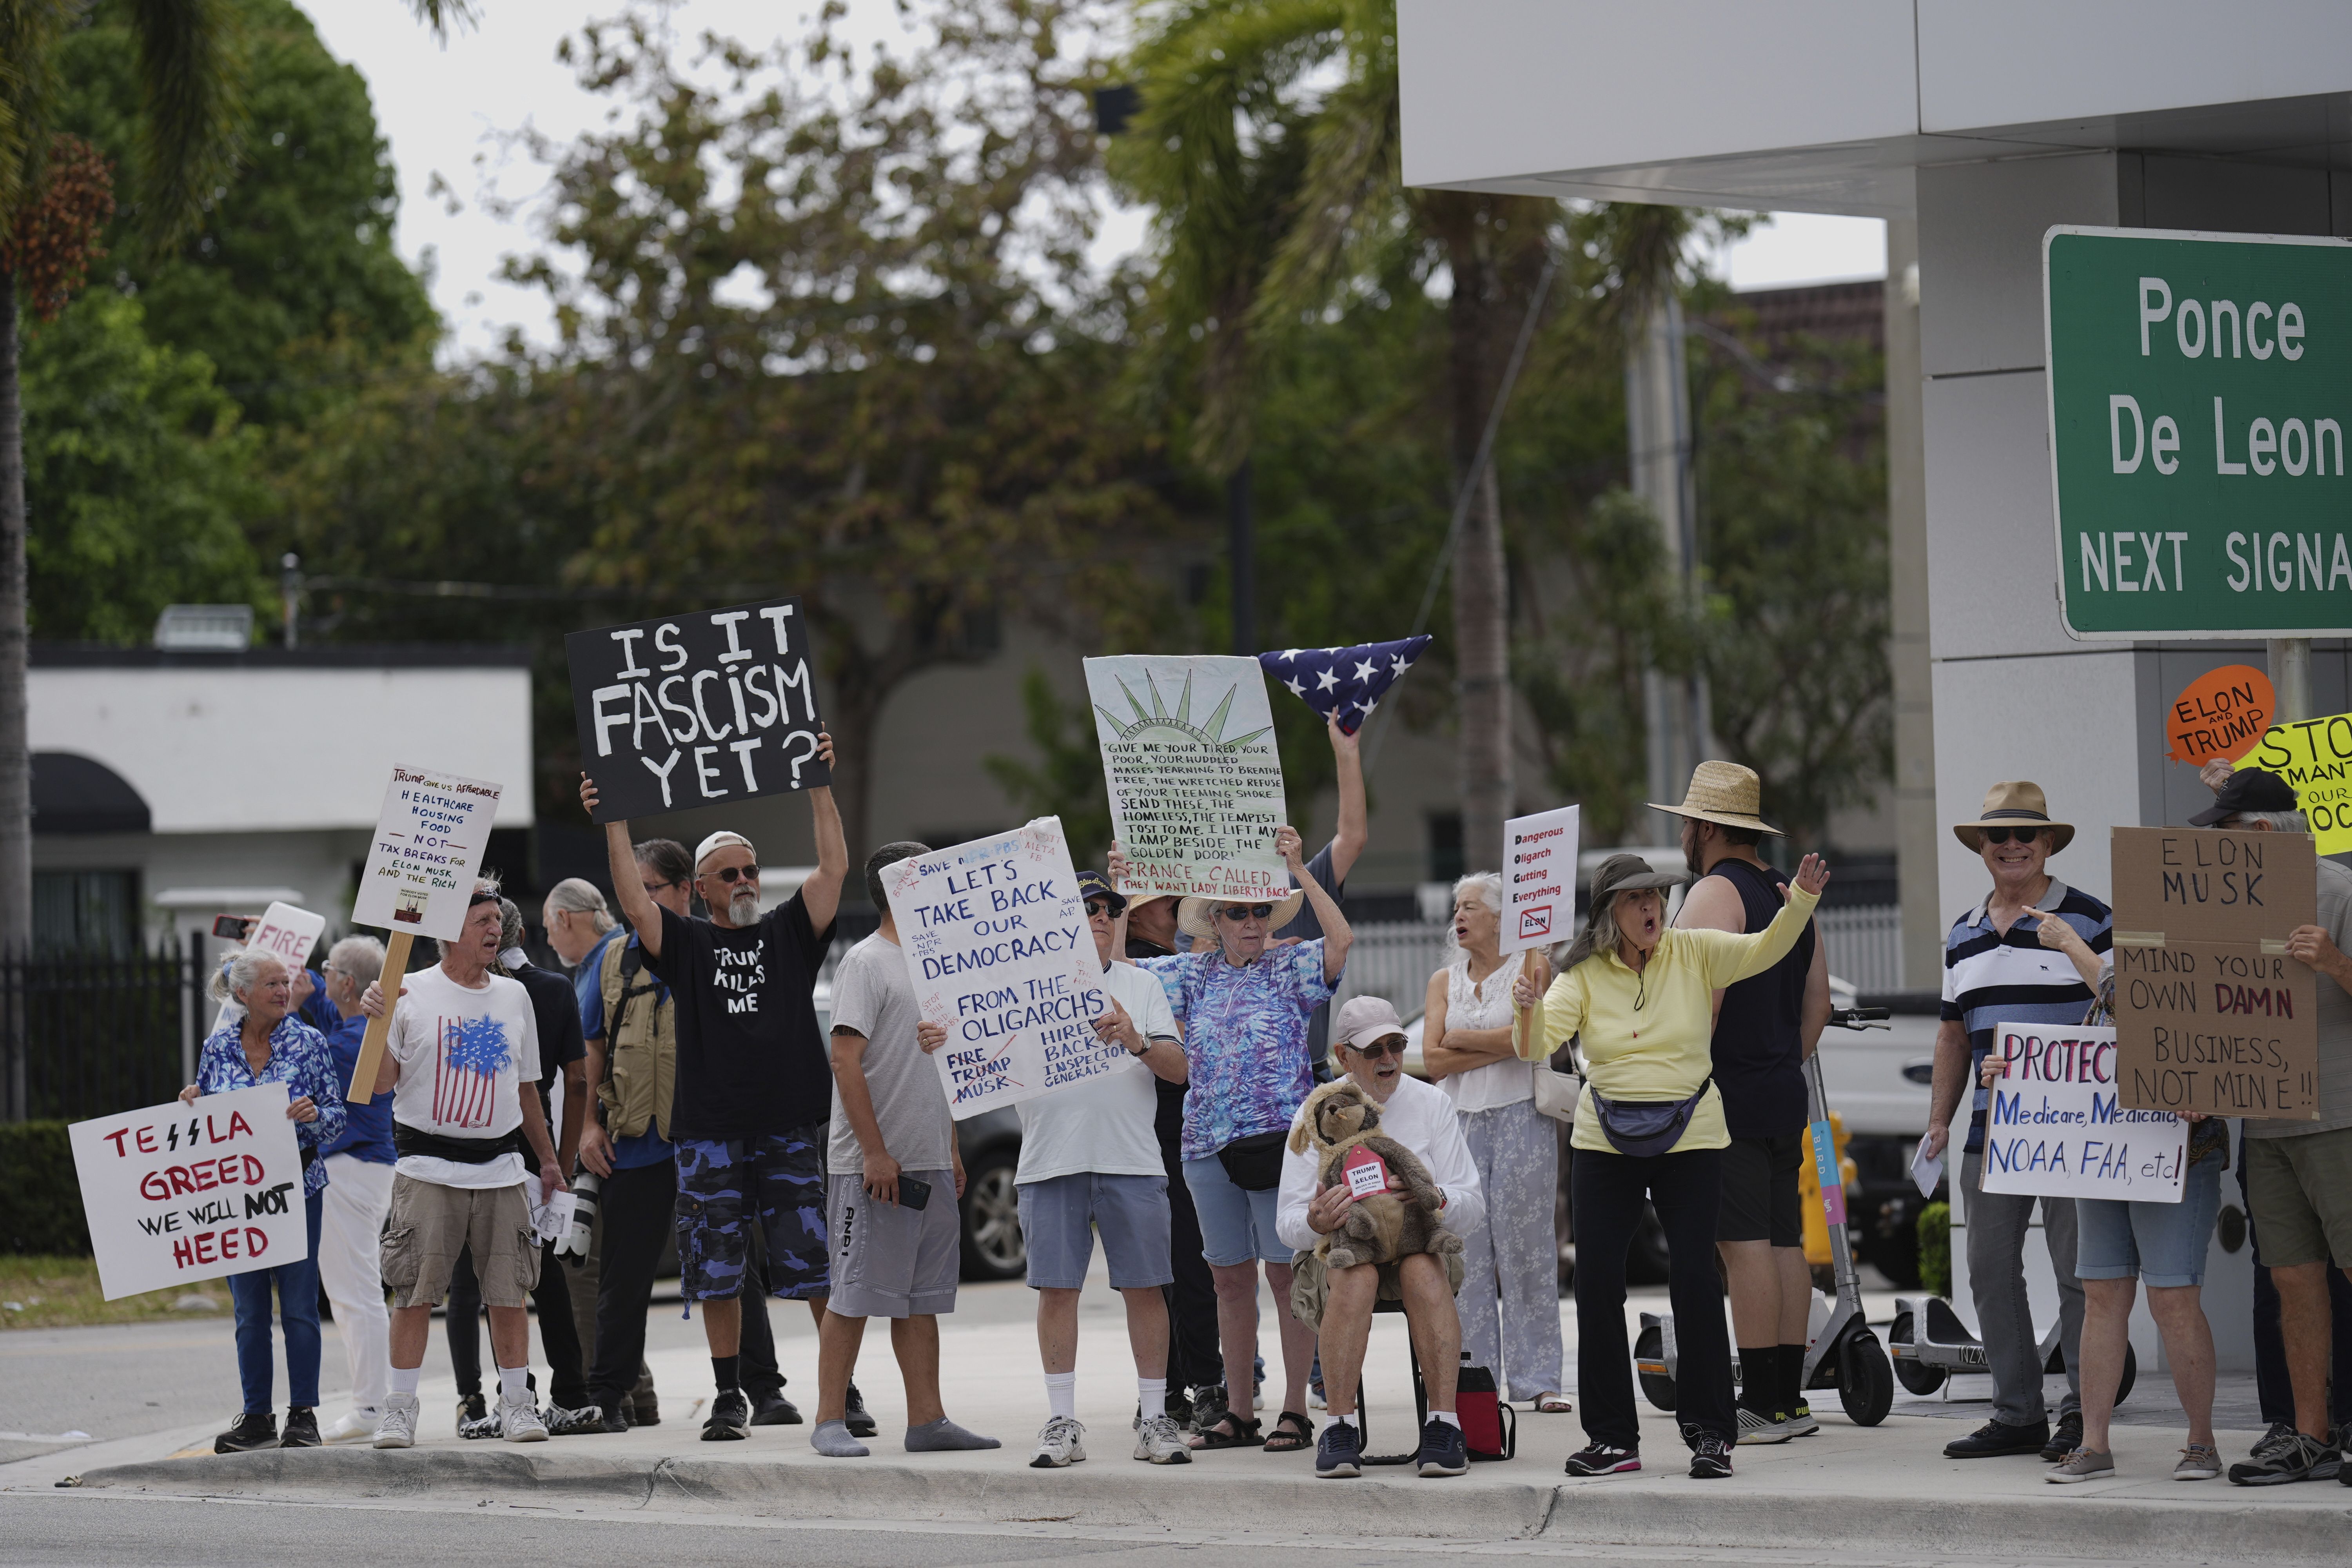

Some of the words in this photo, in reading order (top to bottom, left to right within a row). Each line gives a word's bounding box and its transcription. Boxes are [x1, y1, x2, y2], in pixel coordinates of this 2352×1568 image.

[2139, 277, 2305, 361] Ponce
[2109, 394, 2181, 475] De
[2214, 396, 2344, 476] Leon
[2080, 532, 2189, 592] NEXT
[610, 623, 688, 679] IS
[711, 604, 793, 664] IT
[2176, 682, 2254, 723] ELON
[2209, 711, 2233, 724] AND
[2177, 709, 2263, 756] TRUMP
[1113, 755, 1148, 764] POOR,
[1151, 755, 1184, 764] YOUR
[1143, 744, 1160, 753] ME
[1165, 744, 1196, 754] YOUR
[1202, 744, 1238, 755] TIRED,
[1240, 746, 1269, 754] YOUR
[1156, 766, 1214, 774] YEARNING
[1219, 766, 1234, 775] TO
[1239, 766, 1281, 775] BREATHE
[456, 784, 500, 799] AFFORDABLE
[1115, 777, 1149, 786] FREE,
[1178, 778, 1243, 786] WRETCHED
[1247, 779, 1281, 787] REFUSE
[1117, 788, 1131, 797] OF
[1135, 788, 1168, 797] YOUR
[1172, 789, 1231, 798] TEEMING
[402, 790, 474, 812] HEALTHCARE
[1121, 799, 1160, 809] SEND
[1163, 800, 1208, 811] THESE,
[1210, 799, 1235, 809] THE
[2308, 788, 2352, 804] OUR
[413, 806, 464, 824] HOUSING
[1123, 812, 1192, 824] HOMELESS,
[1192, 812, 1215, 823] THE
[1219, 812, 1276, 823] TEMPIST
[421, 821, 451, 834] FOOD
[1125, 824, 1157, 833] TOST
[1160, 825, 1176, 834] TO
[1180, 826, 1203, 835] ME.
[1209, 825, 1218, 833] I
[1223, 826, 1253, 835] LIFT
[1259, 827, 1278, 838] MY
[1515, 827, 1564, 845] Dangerous
[1025, 842, 1054, 855] META
[1131, 835, 1169, 845] LAMP
[1174, 837, 1226, 848] BESIDE
[1236, 838, 1262, 849] THE
[2162, 838, 2262, 868] ELON
[379, 843, 399, 855] TAX
[404, 848, 447, 864] BREAKS
[450, 857, 465, 867] FOR
[920, 861, 951, 876] SAVE
[994, 840, 1019, 855] PBS
[1131, 848, 1183, 859] GOLDEN
[1514, 848, 1551, 864] Oligarch
[378, 867, 400, 878] AND
[407, 874, 426, 884] THE
[432, 877, 457, 890] RICH
[392, 860, 420, 871] ELON
[426, 867, 452, 878] MUSK
[947, 859, 1017, 895] LET'S
[1125, 862, 1192, 879] FRANCE
[1209, 866, 1270, 886] CALLED
[1514, 869, 1547, 883] Gutting
[1078, 878, 1092, 889] Blue
[1124, 880, 1148, 891] THEY
[1156, 881, 1187, 893] WANT
[1192, 883, 1217, 895] LADY
[1223, 884, 1263, 897] LIBERTY
[1267, 887, 1289, 898] BACK
[1512, 885, 1561, 903] Everything
[2163, 872, 2263, 907] MUSK
[915, 898, 974, 927] TAKE
[991, 880, 1058, 911] BACK
[1062, 895, 1081, 905] SAVE
[974, 915, 1028, 936] OUR
[1525, 916, 1546, 927] ELON
[257, 925, 311, 958] FIRE
[912, 930, 938, 942] SAVE
[918, 938, 942, 949] NPR
[922, 926, 1080, 980] DEMOCRACY
[2123, 947, 2195, 973] MIND
[2214, 955, 2284, 979] YOUR
[714, 965, 765, 992] KILLS
[728, 993, 758, 1013] ME
[922, 992, 939, 1010] STOP
[957, 987, 1018, 1016] FROM
[1024, 975, 1070, 1000] THE
[2130, 979, 2196, 1013] OWN
[2215, 983, 2294, 1019] DAMN
[962, 989, 1104, 1041] OLIGARCHS
[1041, 1021, 1089, 1045] HIRE
[947, 1047, 987, 1069] FIRE
[1045, 1036, 1099, 1062] BACK
[2154, 1027, 2288, 1073] BUSINESS,
[951, 1057, 1011, 1083] TRUMP
[1045, 1062, 1110, 1087] GENERALS
[957, 1076, 1009, 1103] MUSK
[2134, 1068, 2198, 1105] NOT
[1994, 1089, 2087, 1128] Medicare,
[1813, 1135, 1826, 1174] BIRD
[1989, 1138, 2071, 1179] NOAA,
[2081, 1141, 2132, 1185] FAA,
[140, 1154, 265, 1201] GREED
[1352, 1165, 1376, 1176] TRUMP
[1355, 1174, 1378, 1184] &ELON
[138, 1212, 182, 1236] WE
[187, 1198, 238, 1225] WILL
[245, 1182, 294, 1220] NOT
[173, 1227, 268, 1269] HEED
